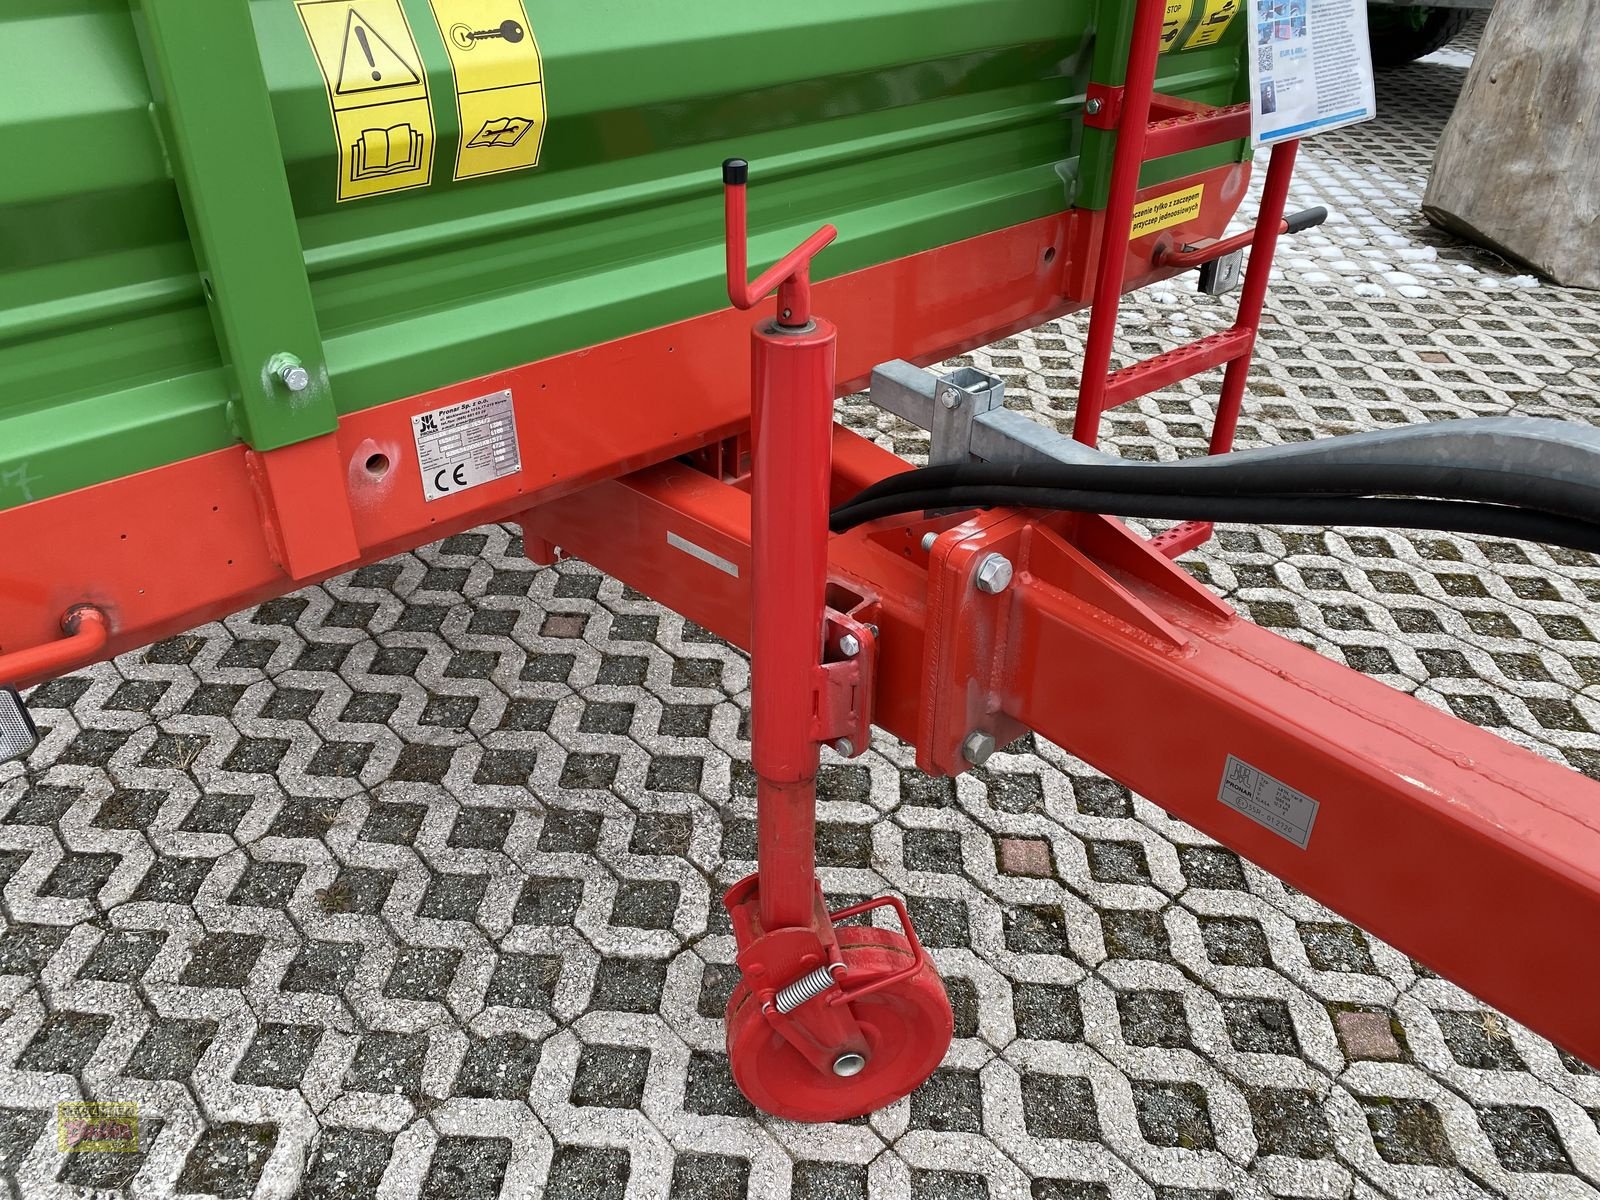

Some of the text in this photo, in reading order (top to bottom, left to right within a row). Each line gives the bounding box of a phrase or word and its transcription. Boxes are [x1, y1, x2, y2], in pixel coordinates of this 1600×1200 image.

[1166, 4, 1182, 14] STOP
[1154, 202, 1168, 213] tylko
[1173, 193, 1200, 206] zaczepem
[1132, 203, 1199, 231] przyczep jednoosiowych
[438, 406, 460, 416] Pronar
[435, 463, 467, 491] CE
[1225, 780, 1252, 797] PRONAR
